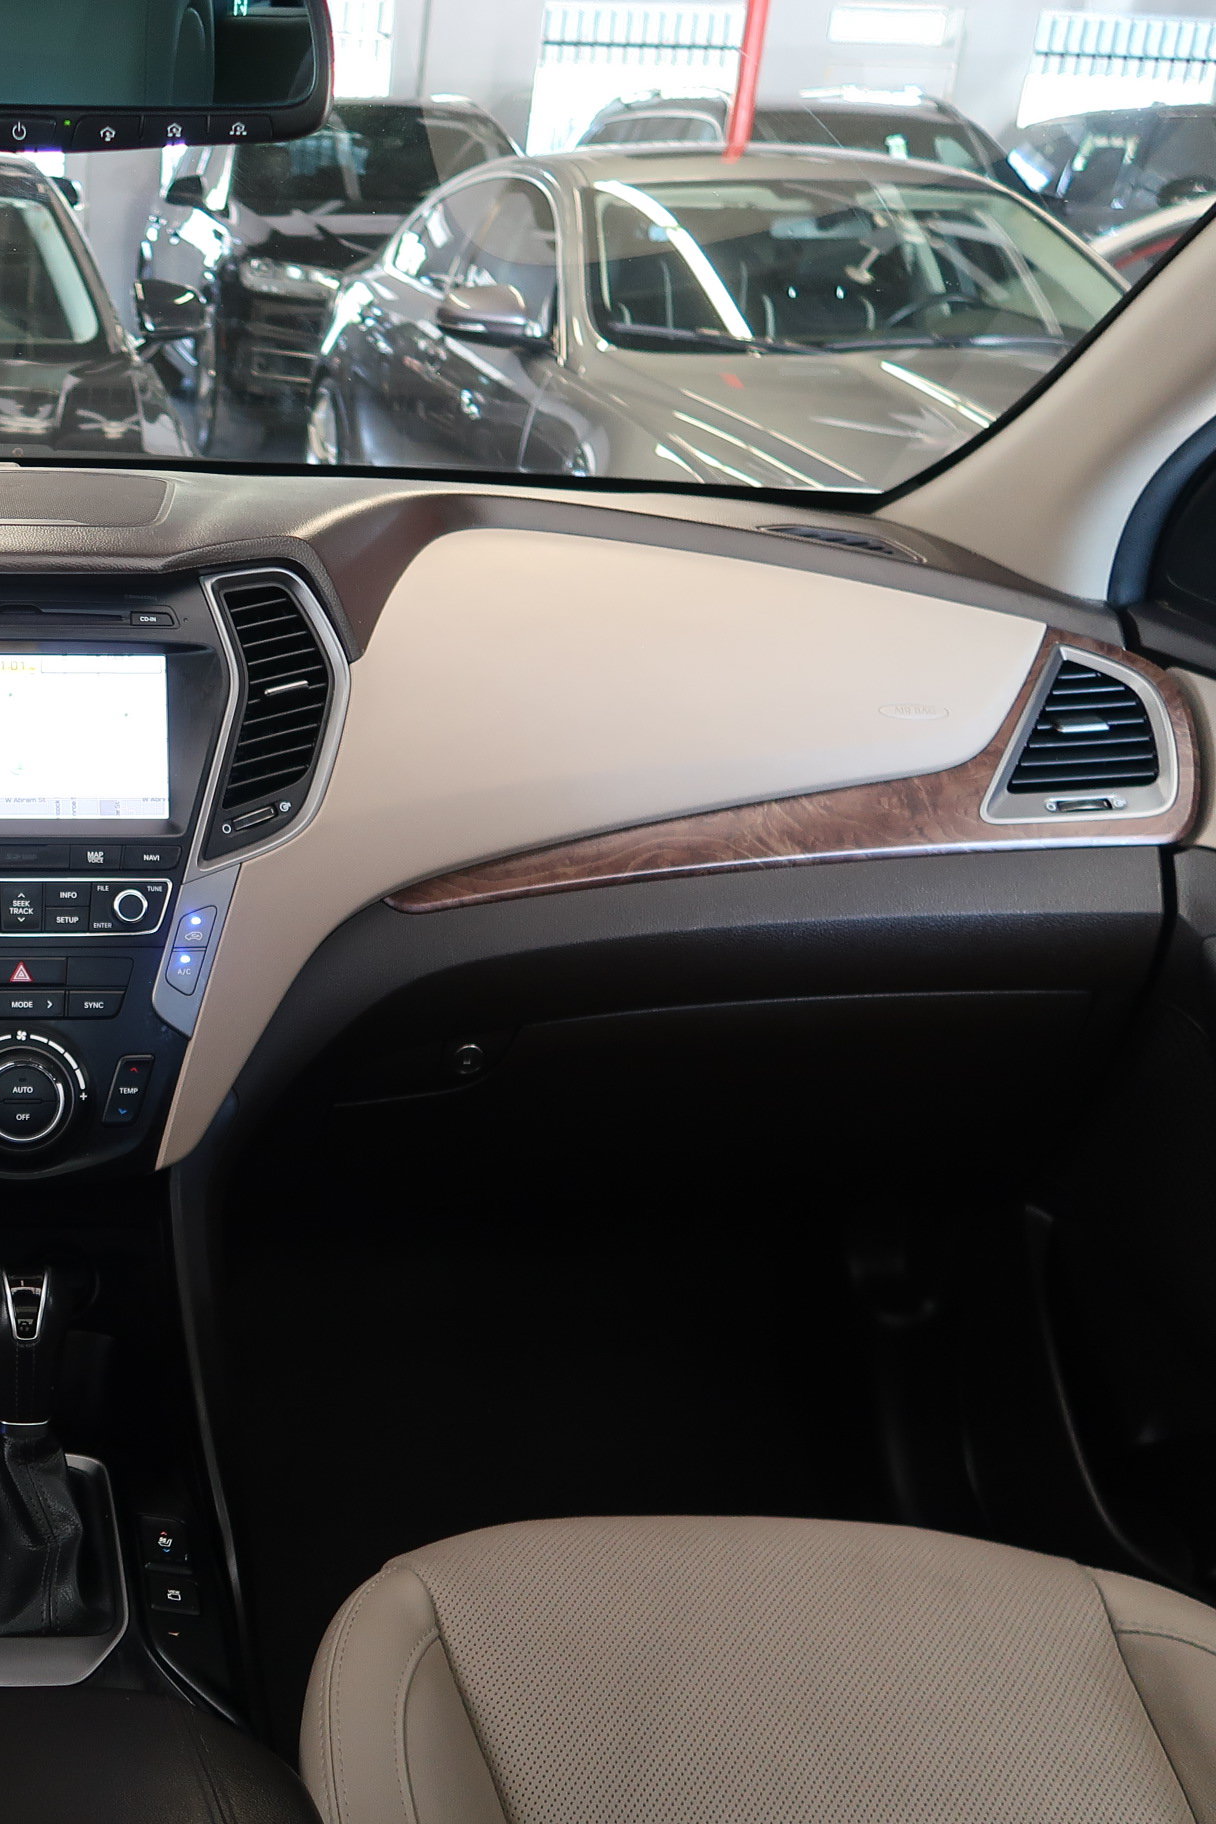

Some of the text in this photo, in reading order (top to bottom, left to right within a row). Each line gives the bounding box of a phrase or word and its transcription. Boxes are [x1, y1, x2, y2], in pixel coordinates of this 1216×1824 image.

[84, 1001, 104, 1009] SYNC
[12, 1086, 34, 1094] AUTO
[119, 1087, 139, 1095] TEMP
